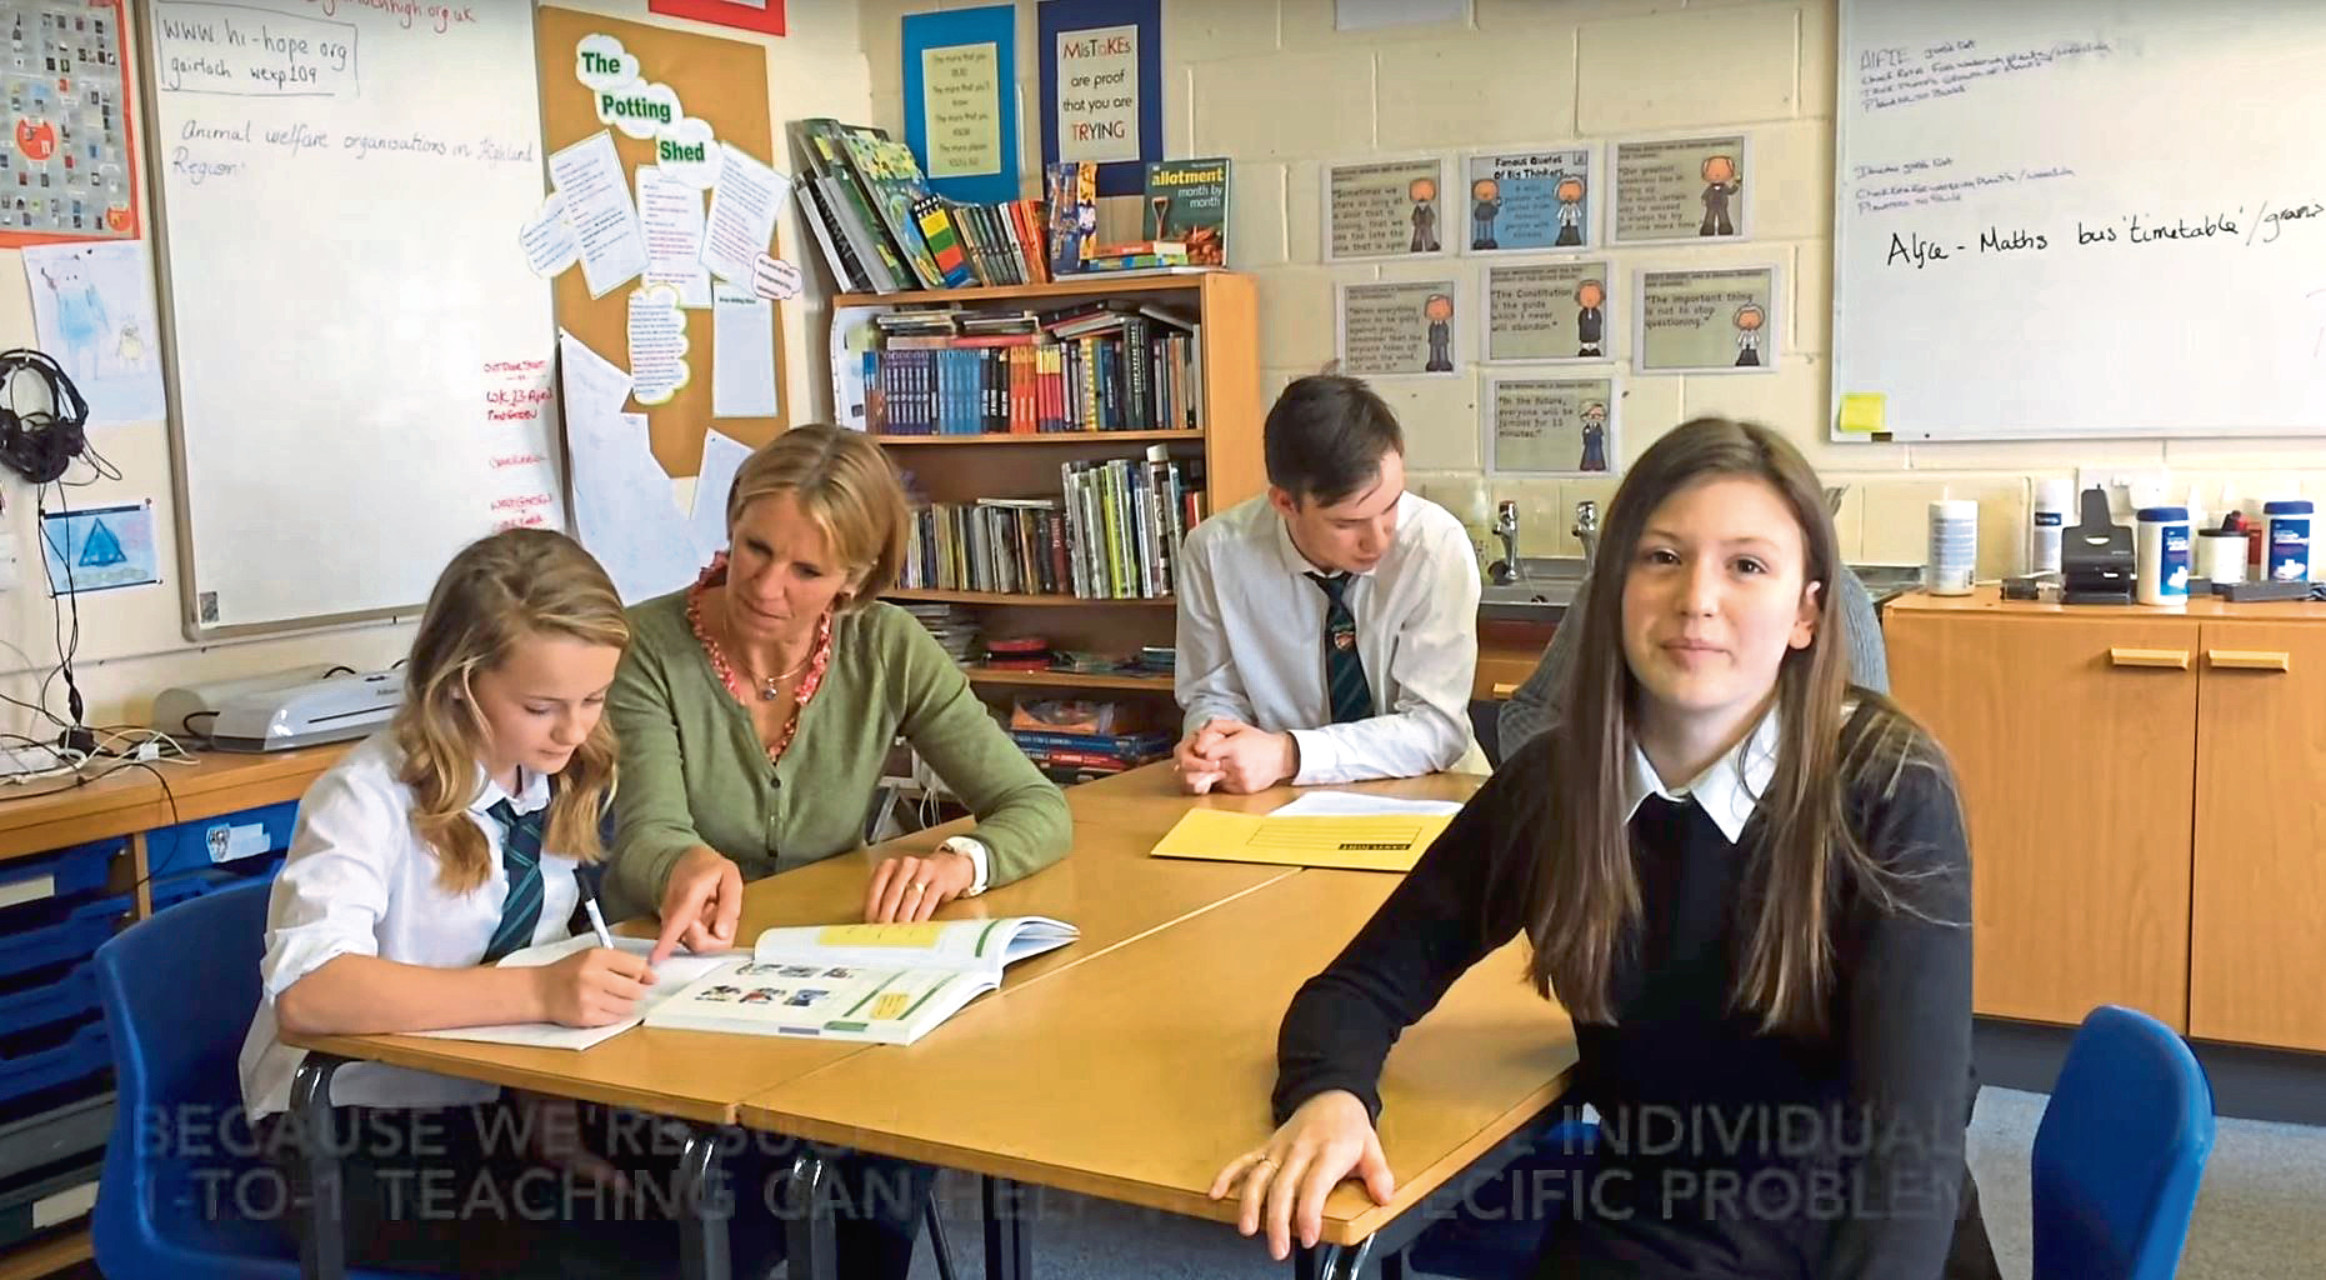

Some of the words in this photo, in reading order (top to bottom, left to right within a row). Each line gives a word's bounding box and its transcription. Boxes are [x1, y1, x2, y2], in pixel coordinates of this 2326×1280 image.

[581, 52, 620, 73] The
[1071, 75, 1090, 88] are
[1094, 69, 1125, 89] proof
[602, 95, 671, 124] Potting
[1063, 98, 1086, 112] that
[1088, 99, 1111, 114] you
[1113, 97, 1132, 109] are
[265, 123, 329, 158] welfare
[1071, 121, 1125, 141] TRYING
[660, 140, 705, 162] Shed
[1152, 167, 1225, 187] allotment
[1178, 185, 1209, 199] month
[1210, 182, 1223, 197] by
[1189, 196, 1221, 209] month
[1980, 225, 2049, 253] Maths
[2078, 221, 2117, 245] bus
